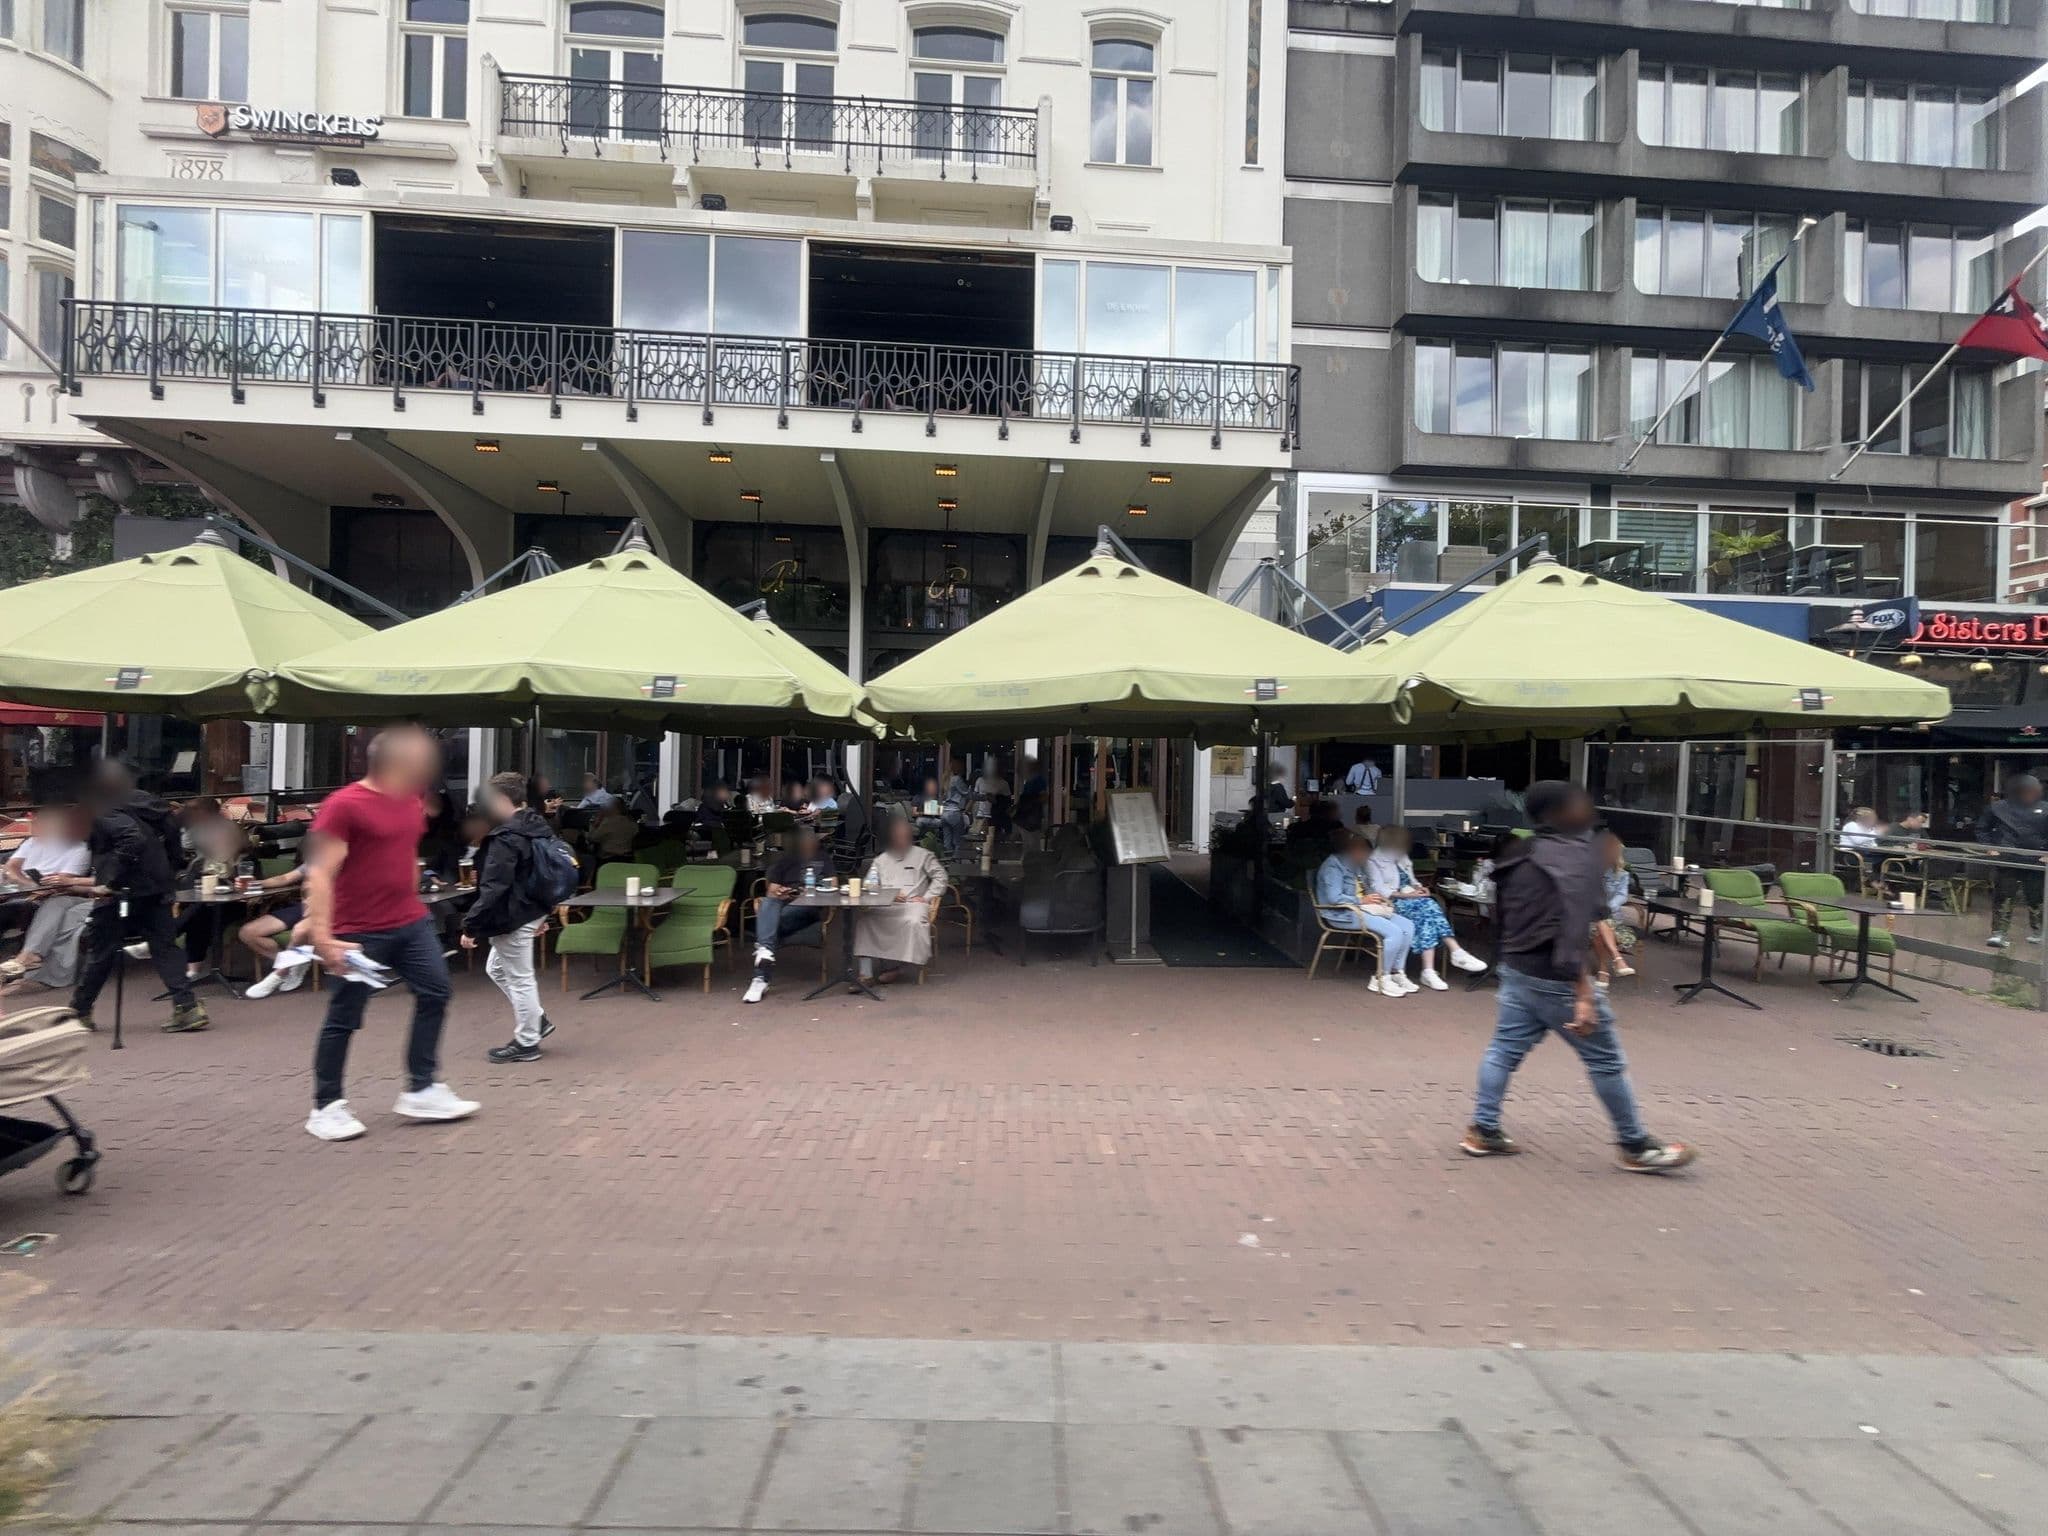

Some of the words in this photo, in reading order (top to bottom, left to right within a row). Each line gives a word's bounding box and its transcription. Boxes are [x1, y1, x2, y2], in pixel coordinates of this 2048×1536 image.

[171, 159, 224, 181] 1898
[1871, 612, 1897, 624] FOX
[1929, 612, 2028, 642] Sisters
